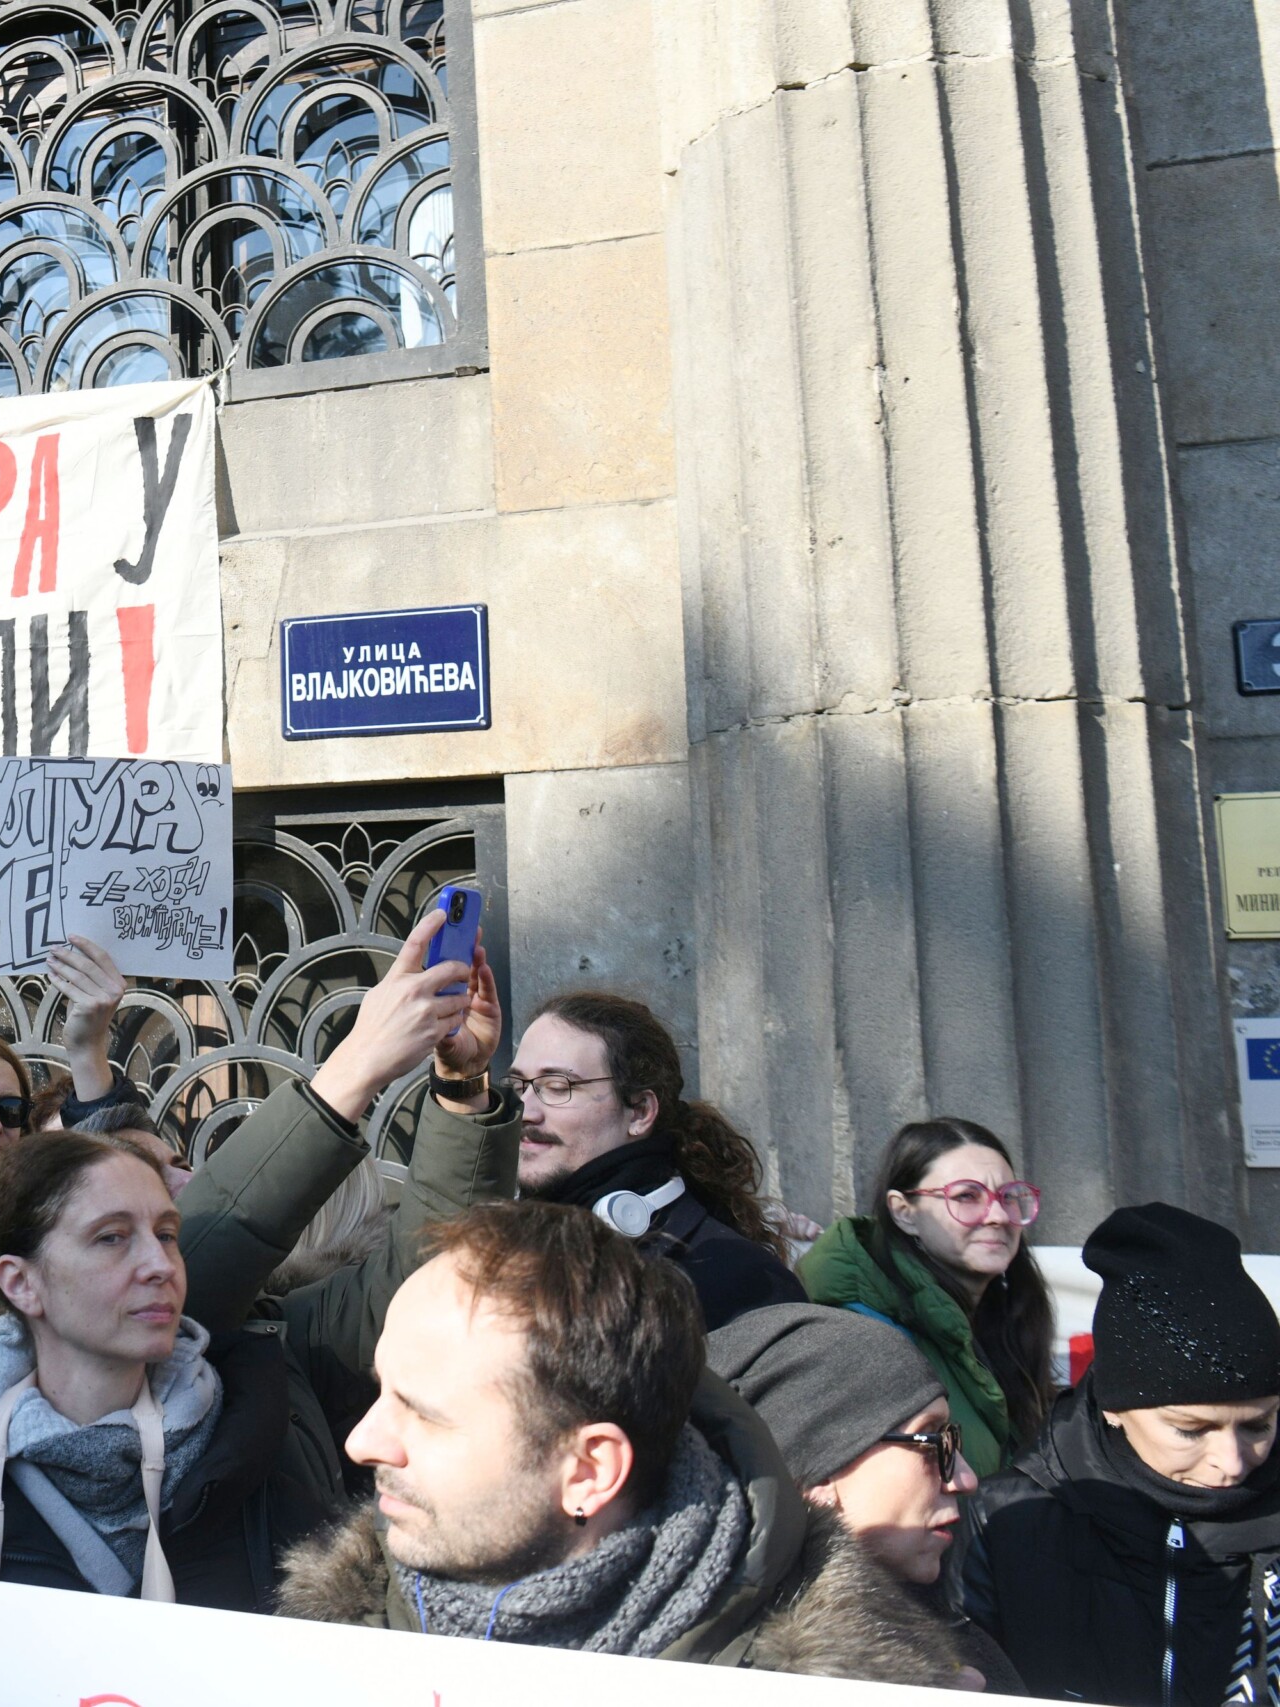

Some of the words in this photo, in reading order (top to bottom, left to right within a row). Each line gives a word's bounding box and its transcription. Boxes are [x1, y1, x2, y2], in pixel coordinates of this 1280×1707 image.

[113, 413, 192, 585] У
[342, 641, 422, 664] УЛИЦА
[291, 661, 476, 702] ВЛАЈКОВИЋЕВА
[133, 856, 211, 905] ХОБИ
